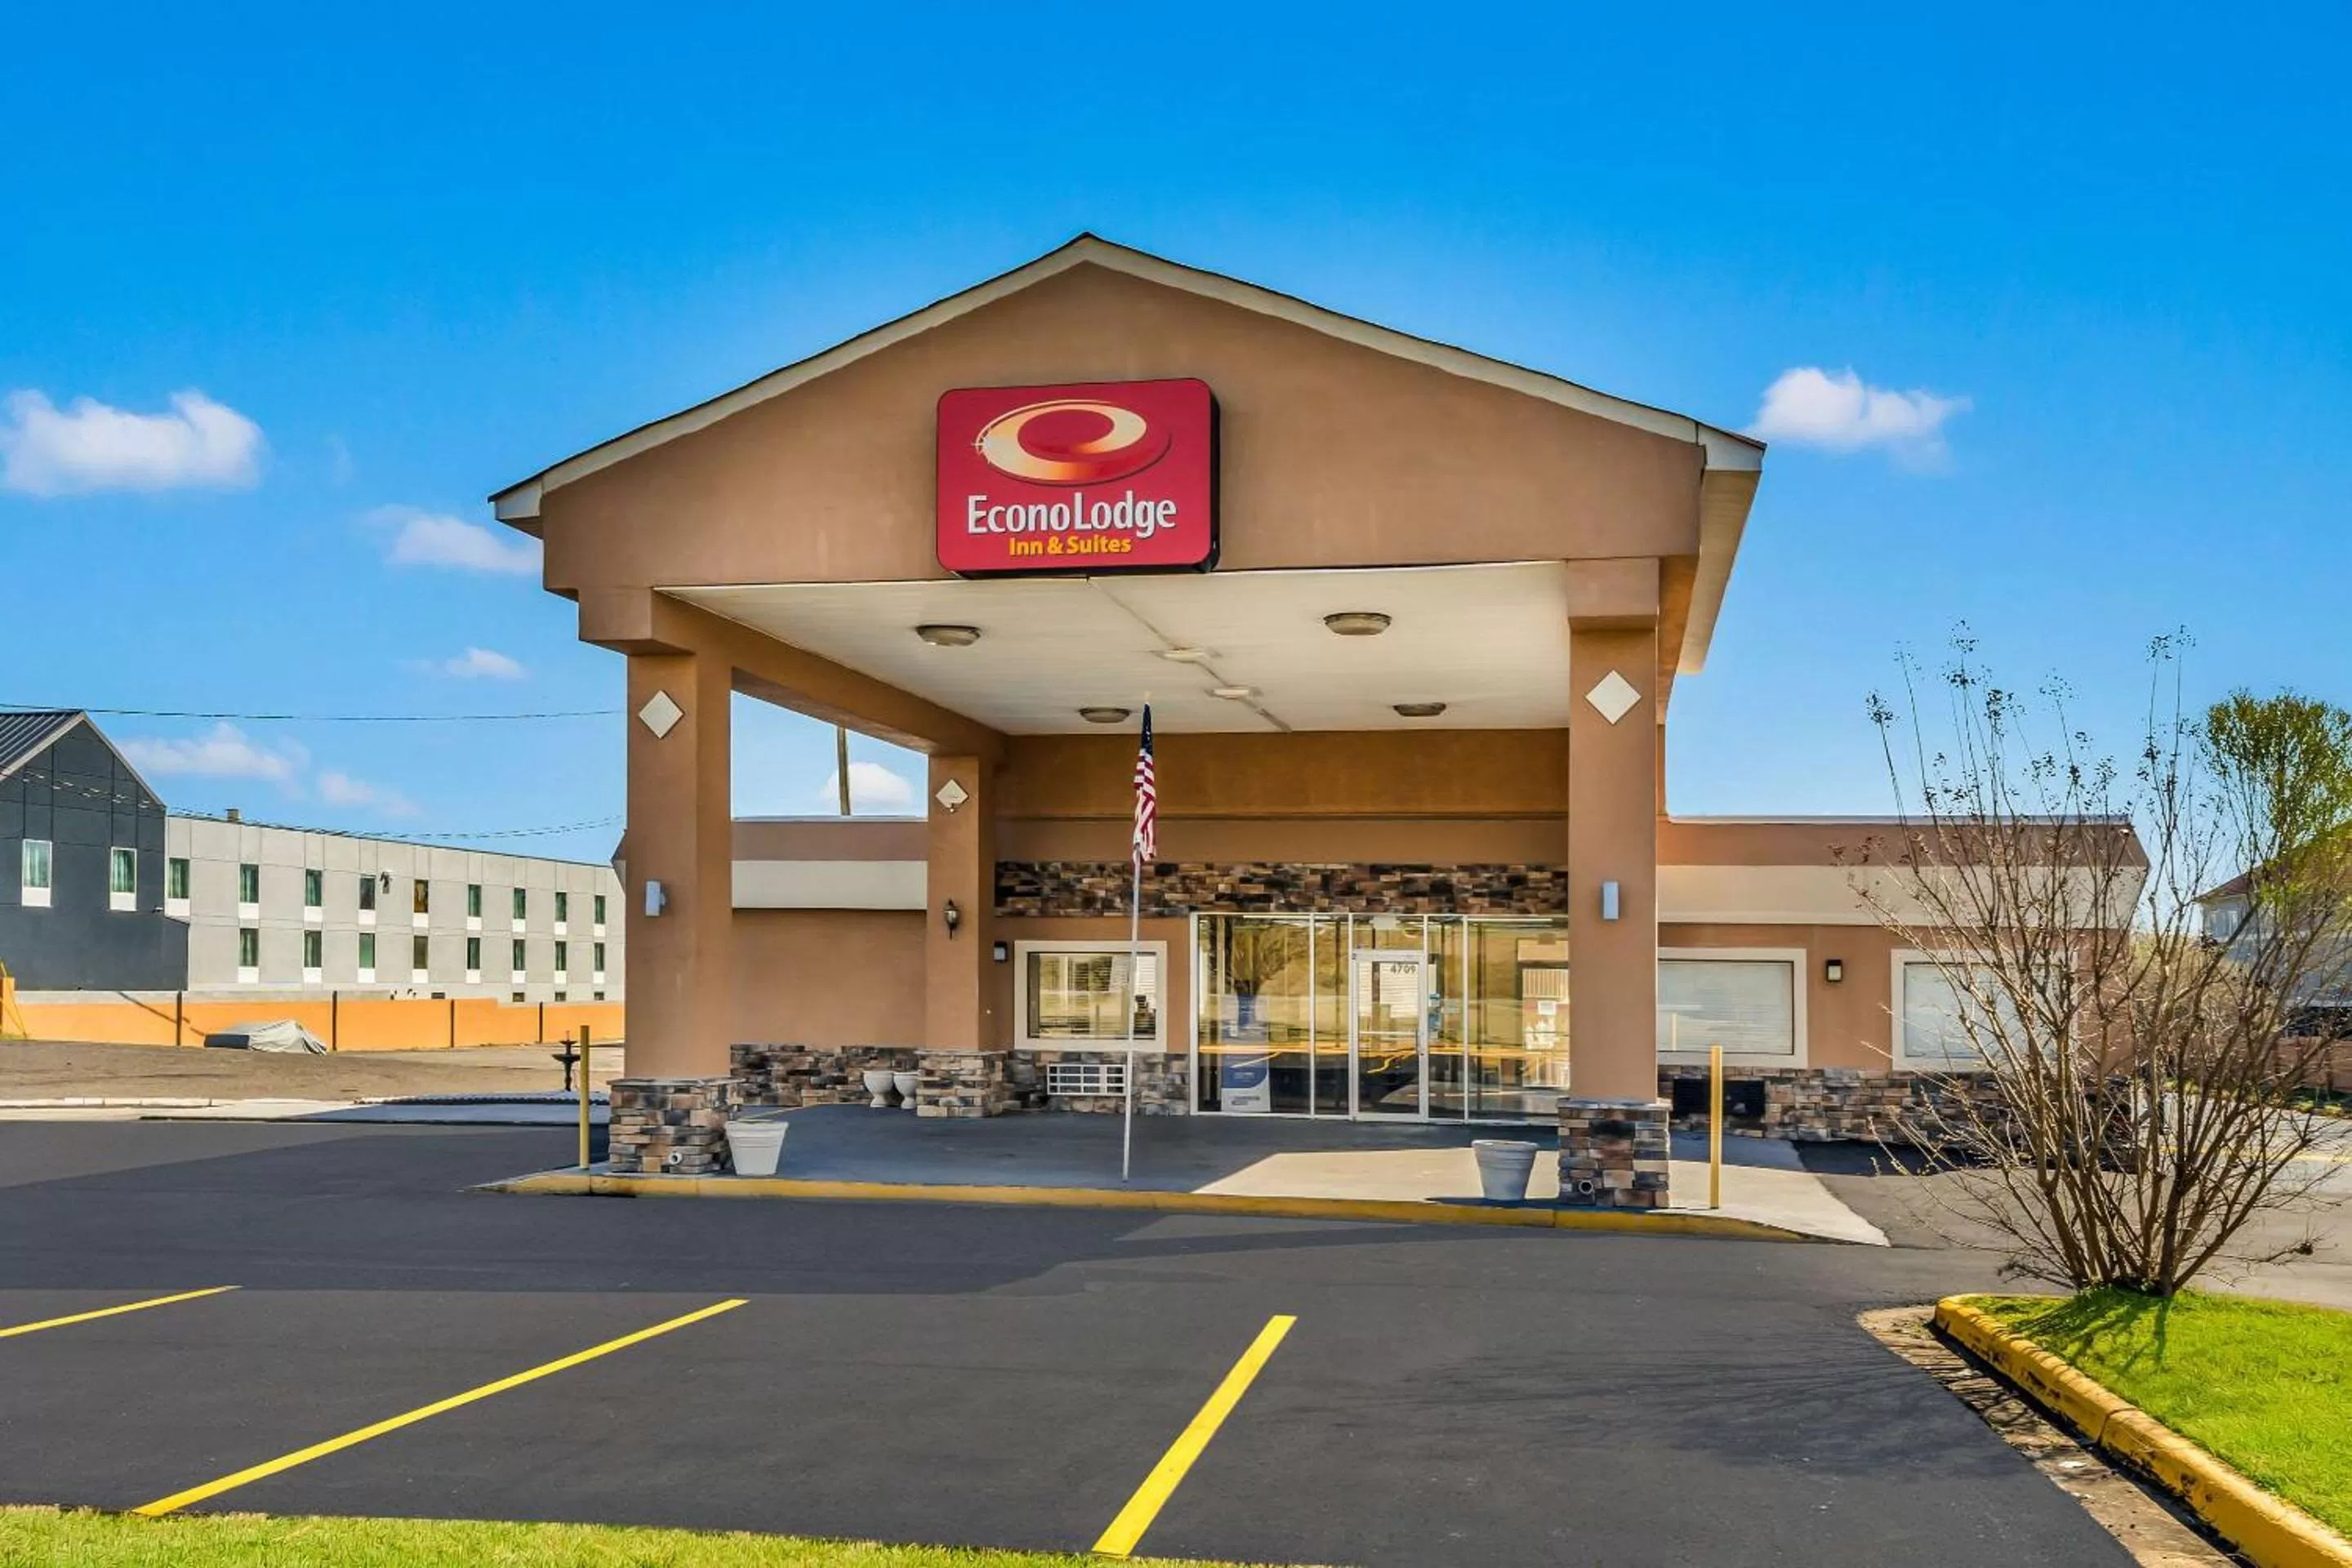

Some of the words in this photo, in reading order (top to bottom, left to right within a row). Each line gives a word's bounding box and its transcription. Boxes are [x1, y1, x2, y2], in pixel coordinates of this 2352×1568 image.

[968, 490, 1177, 539] EconoLodge
[1009, 537, 1044, 557] Inn
[1047, 535, 1064, 555] &
[1066, 533, 1132, 555] Suites
[1390, 963, 1416, 974] 4709
